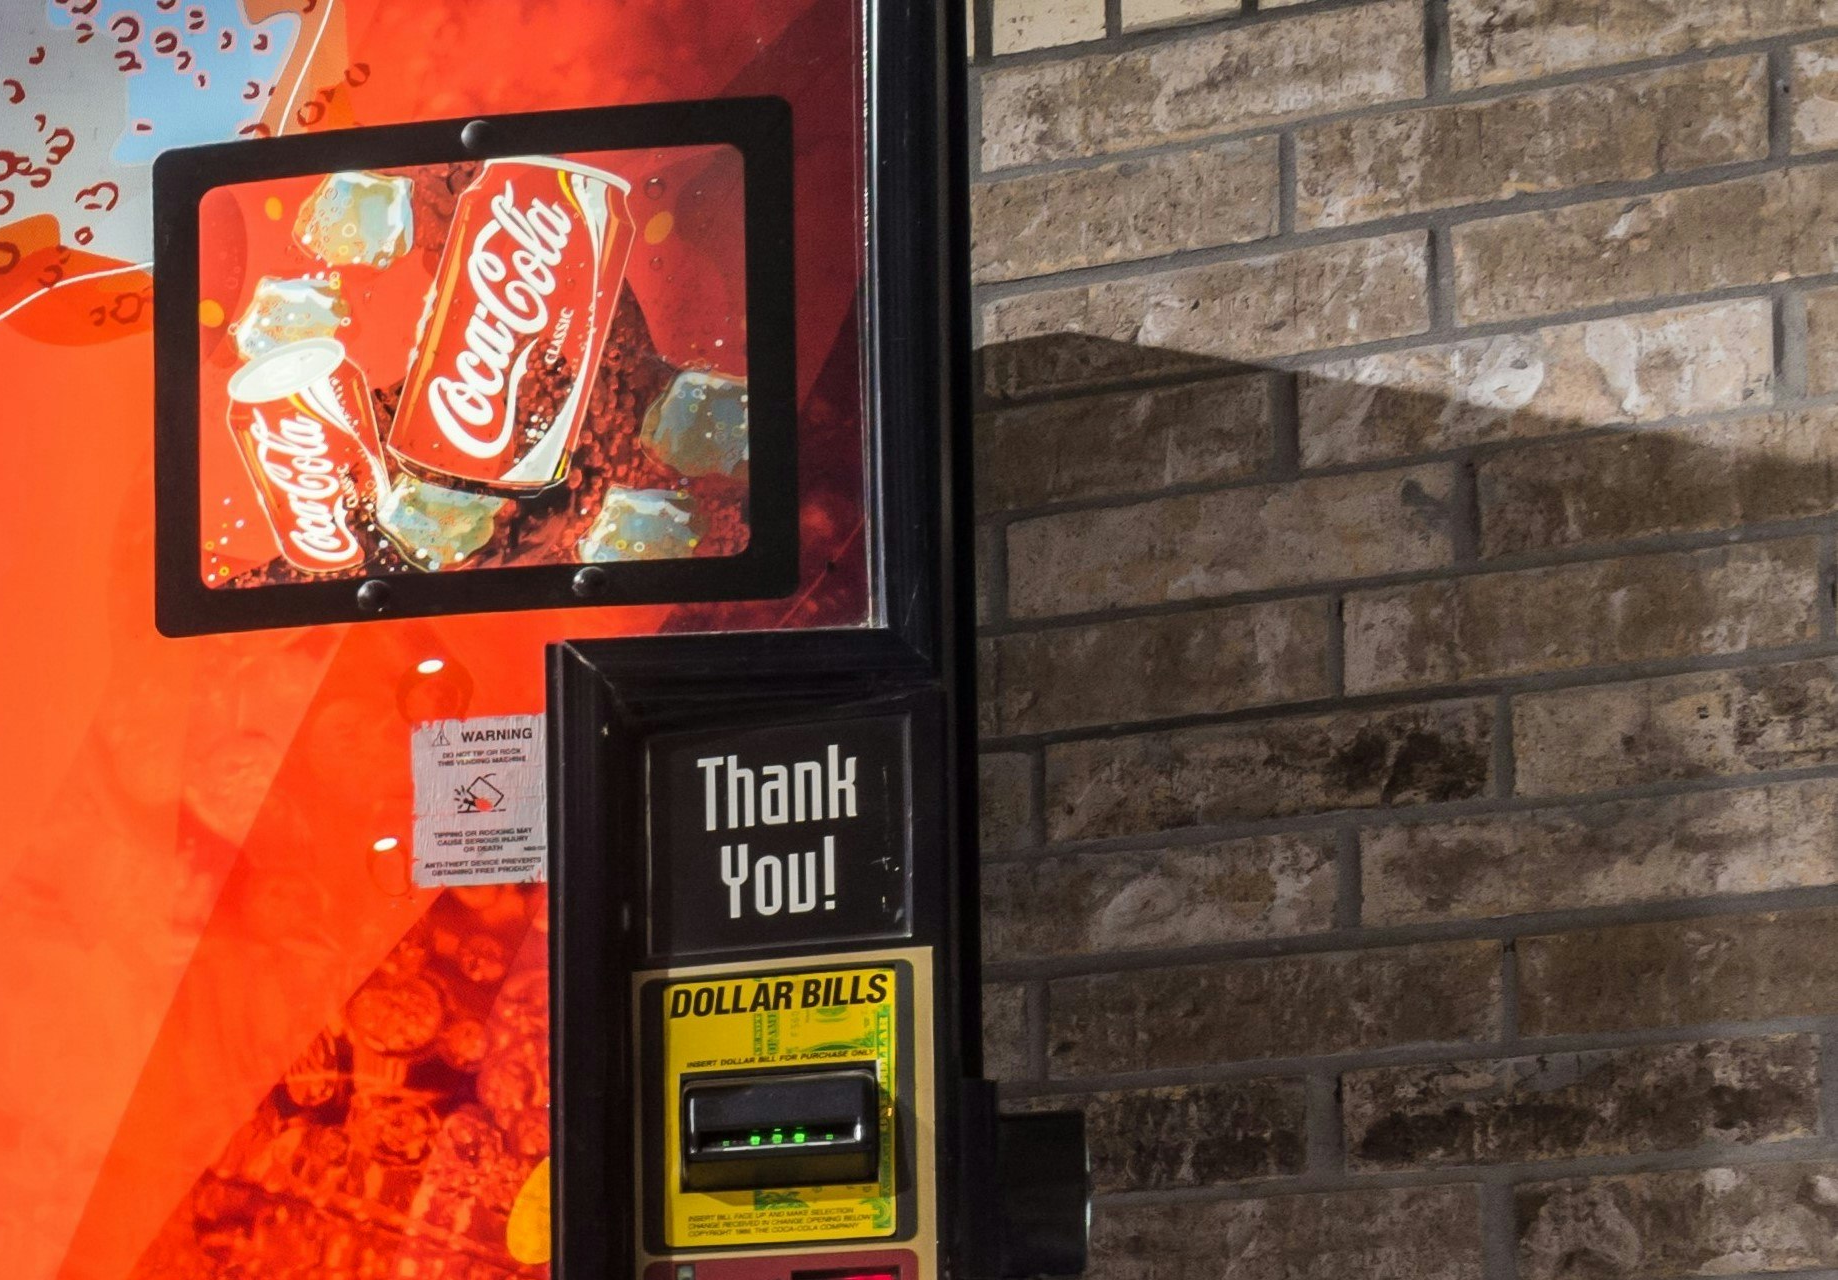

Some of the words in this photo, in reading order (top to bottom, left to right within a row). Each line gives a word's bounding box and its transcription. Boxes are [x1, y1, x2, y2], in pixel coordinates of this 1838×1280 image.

[428, 179, 573, 459] Coca-Cola
[544, 306, 575, 366] CLASSIC
[250, 407, 359, 562] Coca-Cola
[461, 727, 533, 743] WARNING
[456, 750, 471, 758] NOT
[473, 749, 485, 757] TIP
[456, 758, 490, 766] VENDING
[492, 755, 526, 763] MACHINE
[697, 744, 858, 831] Thank
[465, 837, 500, 845] SERIOUS
[501, 835, 529, 843] INJURY
[479, 828, 515, 836] ROCKING
[425, 860, 469, 869] ANTI-THEFT
[471, 859, 499, 867] DEVICE
[501, 857, 542, 865] PREVENTS
[431, 868, 474, 876] OBTAINING
[497, 864, 535, 872] PRODUCT
[721, 836, 836, 919] You!
[670, 981, 794, 1019] DOLLAR
[801, 973, 888, 1009] BILLS
[686, 1060, 718, 1069] INSERT
[720, 1057, 755, 1066] DOLLAR
[758, 1055, 776, 1064] BILL
[779, 1054, 798, 1062] FOR
[800, 1051, 848, 1060] PURCHASE
[851, 1049, 875, 1058] ONLY
[688, 1214, 716, 1222] INSERT
[769, 1210, 784, 1218] AND
[786, 1209, 808, 1217] MAKE
[810, 1207, 854, 1216] SELECTION
[688, 1221, 720, 1229] CHANGE
[722, 1219, 760, 1228] RECEIVED
[771, 1217, 804, 1225] CHANGE
[806, 1215, 842, 1223] OPENING
[844, 1213, 871, 1222] BELOW
[688, 1228, 733, 1237] COPYRIGHT
[771, 1224, 818, 1233] COCA-COLA
[819, 1222, 859, 1231] COMPANY
